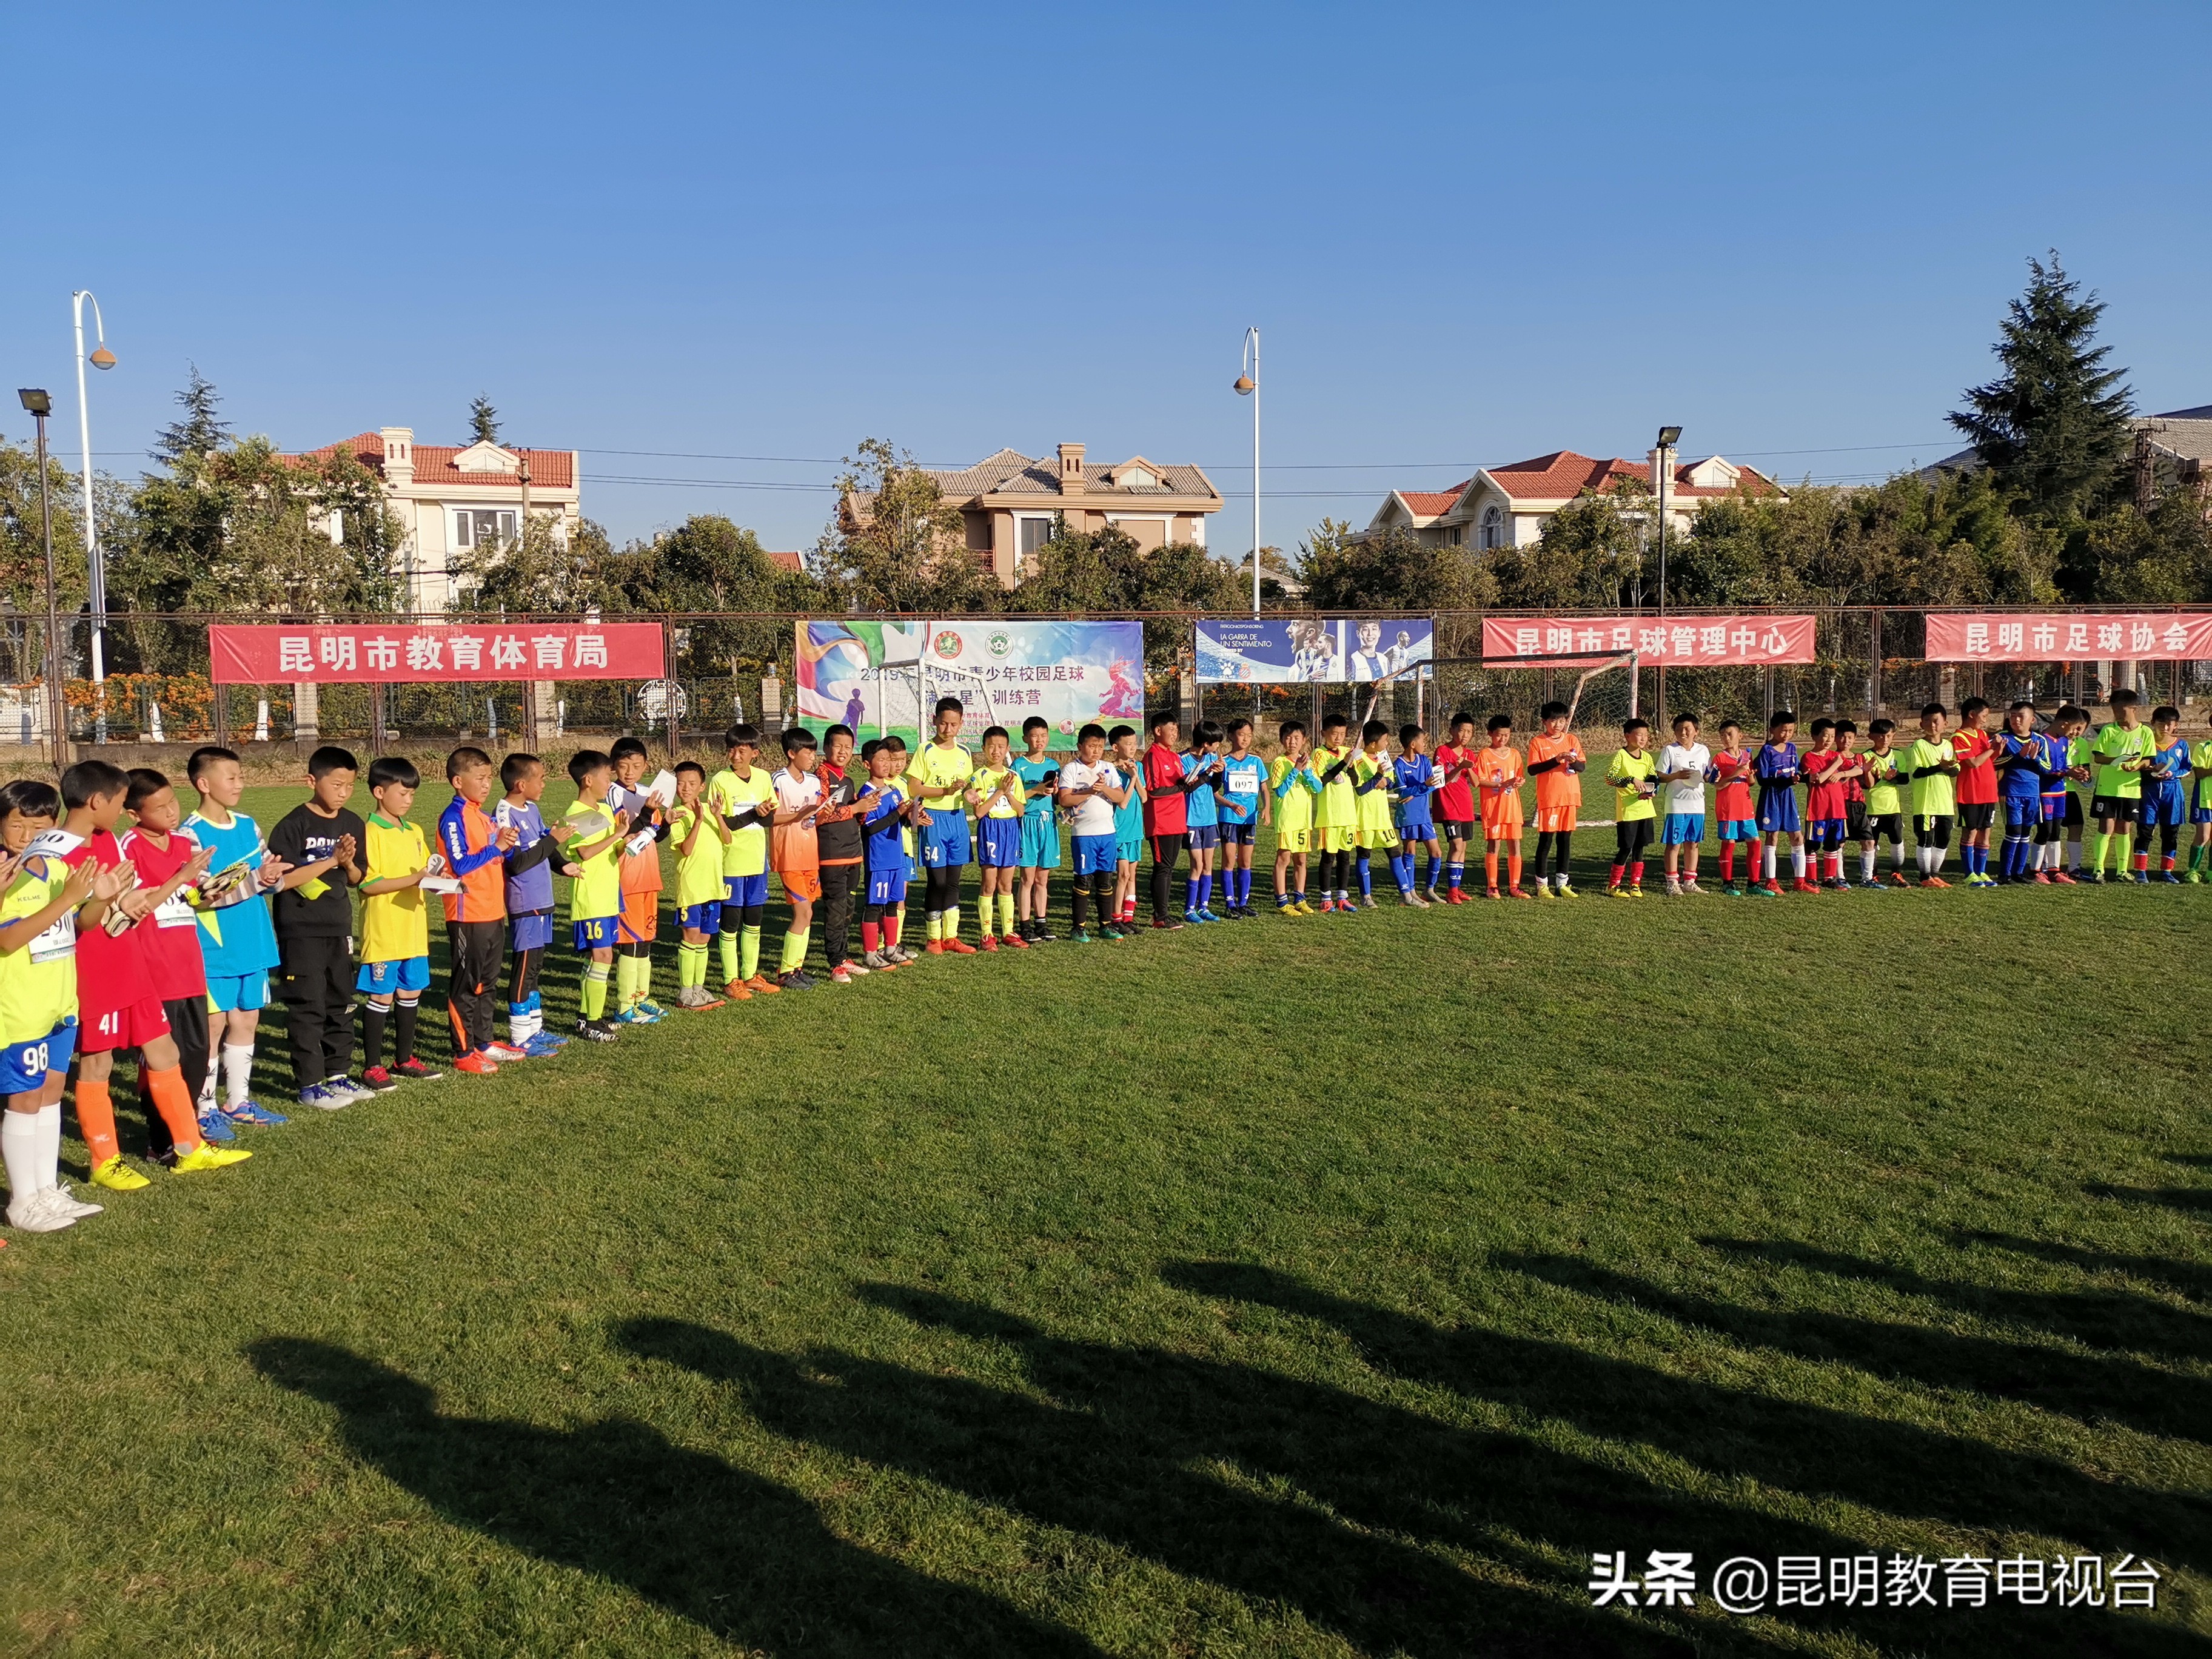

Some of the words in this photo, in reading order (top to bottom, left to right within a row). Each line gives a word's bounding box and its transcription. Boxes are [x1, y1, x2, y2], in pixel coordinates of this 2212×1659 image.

[1515, 626, 1788, 656] 昆明市足球管理中心
[1966, 622, 2188, 652] 昆明市足球协会
[280, 635, 607, 672] 昆明市教育体育局
[860, 665, 1084, 682] 2019明市青少年校园足球
[992, 689, 1041, 705] 训练营
[1235, 780, 1253, 789] 097
[1189, 830, 1195, 843] 7
[1347, 833, 1353, 844] 3
[1382, 830, 1396, 842] 10
[1446, 825, 1456, 836] 11
[1674, 827, 1680, 840] 5
[1298, 833, 1305, 845] 5
[925, 846, 939, 862] 54
[809, 879, 816, 893] 5
[876, 882, 888, 898] 11
[681, 906, 688, 922] 5
[586, 921, 603, 940] 16
[99, 1012, 118, 1036] 41
[23, 1042, 49, 1076] 98
